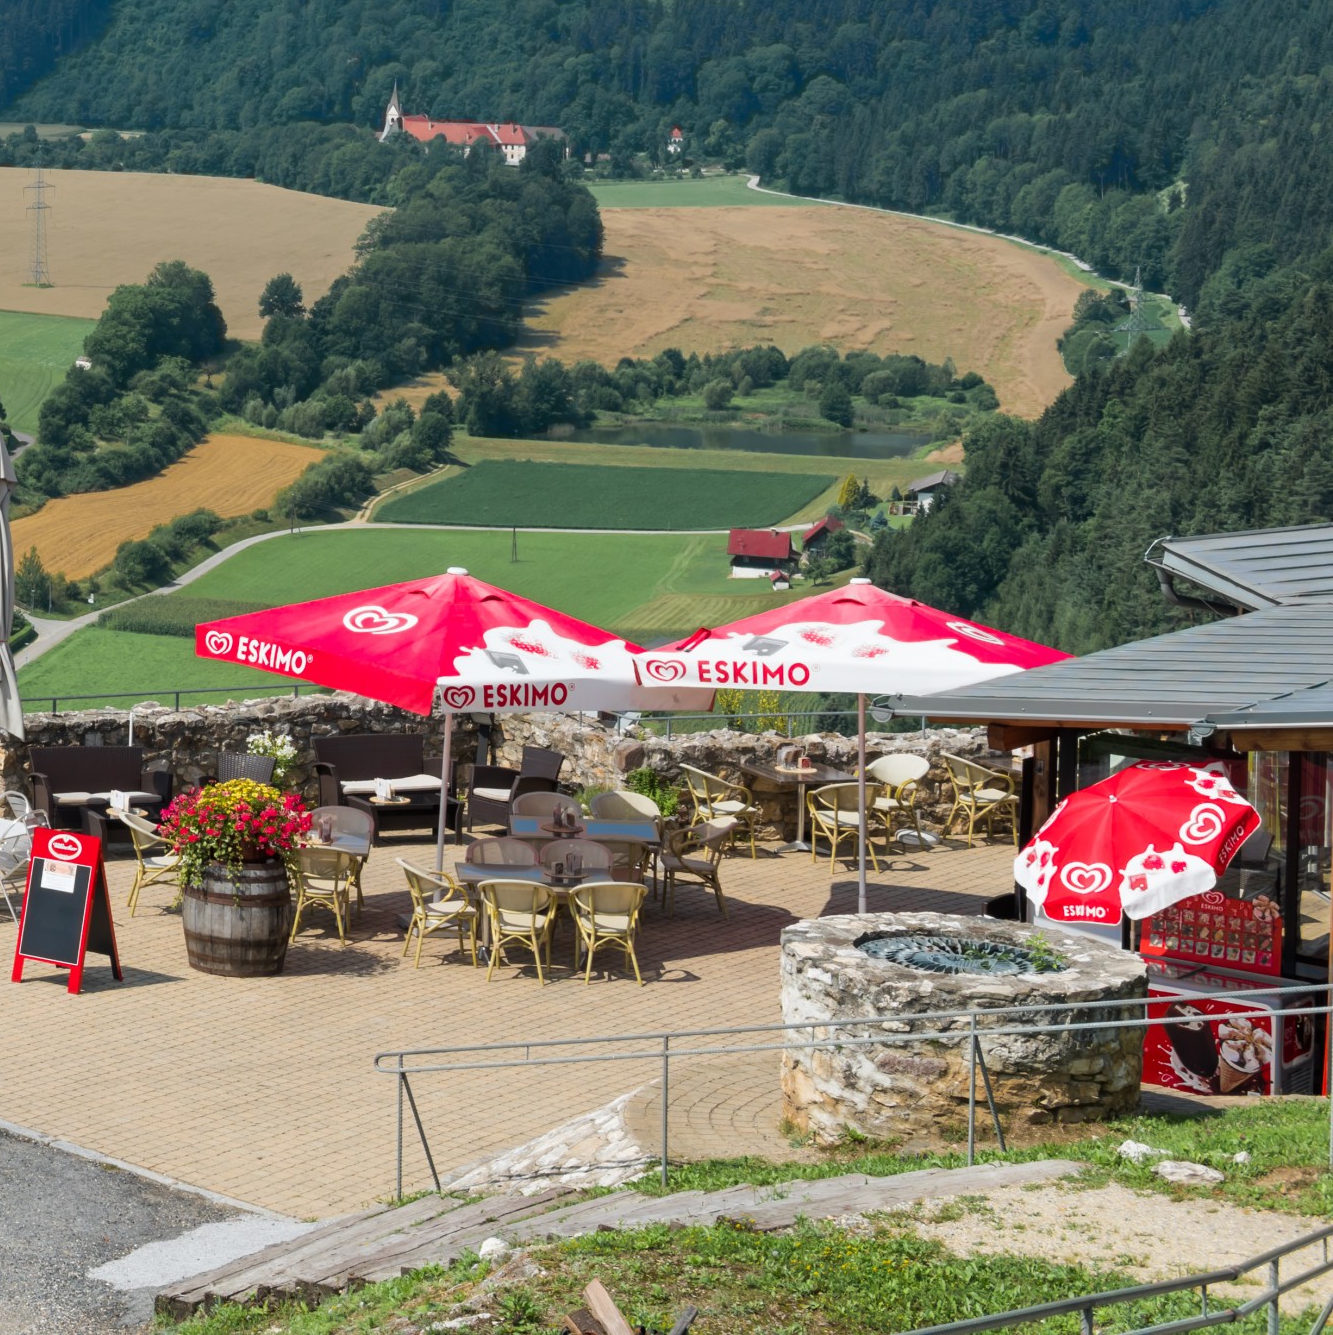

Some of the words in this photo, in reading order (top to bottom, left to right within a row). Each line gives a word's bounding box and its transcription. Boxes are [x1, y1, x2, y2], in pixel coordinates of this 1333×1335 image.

[236, 636, 307, 675] ESKIMO
[697, 660, 811, 686] ESKIMO
[483, 682, 568, 708] ESKIMO
[1218, 825, 1245, 864] ESKIMO
[1063, 905, 1106, 918] ESKIMO
[1200, 902, 1224, 912] ESKIMO
